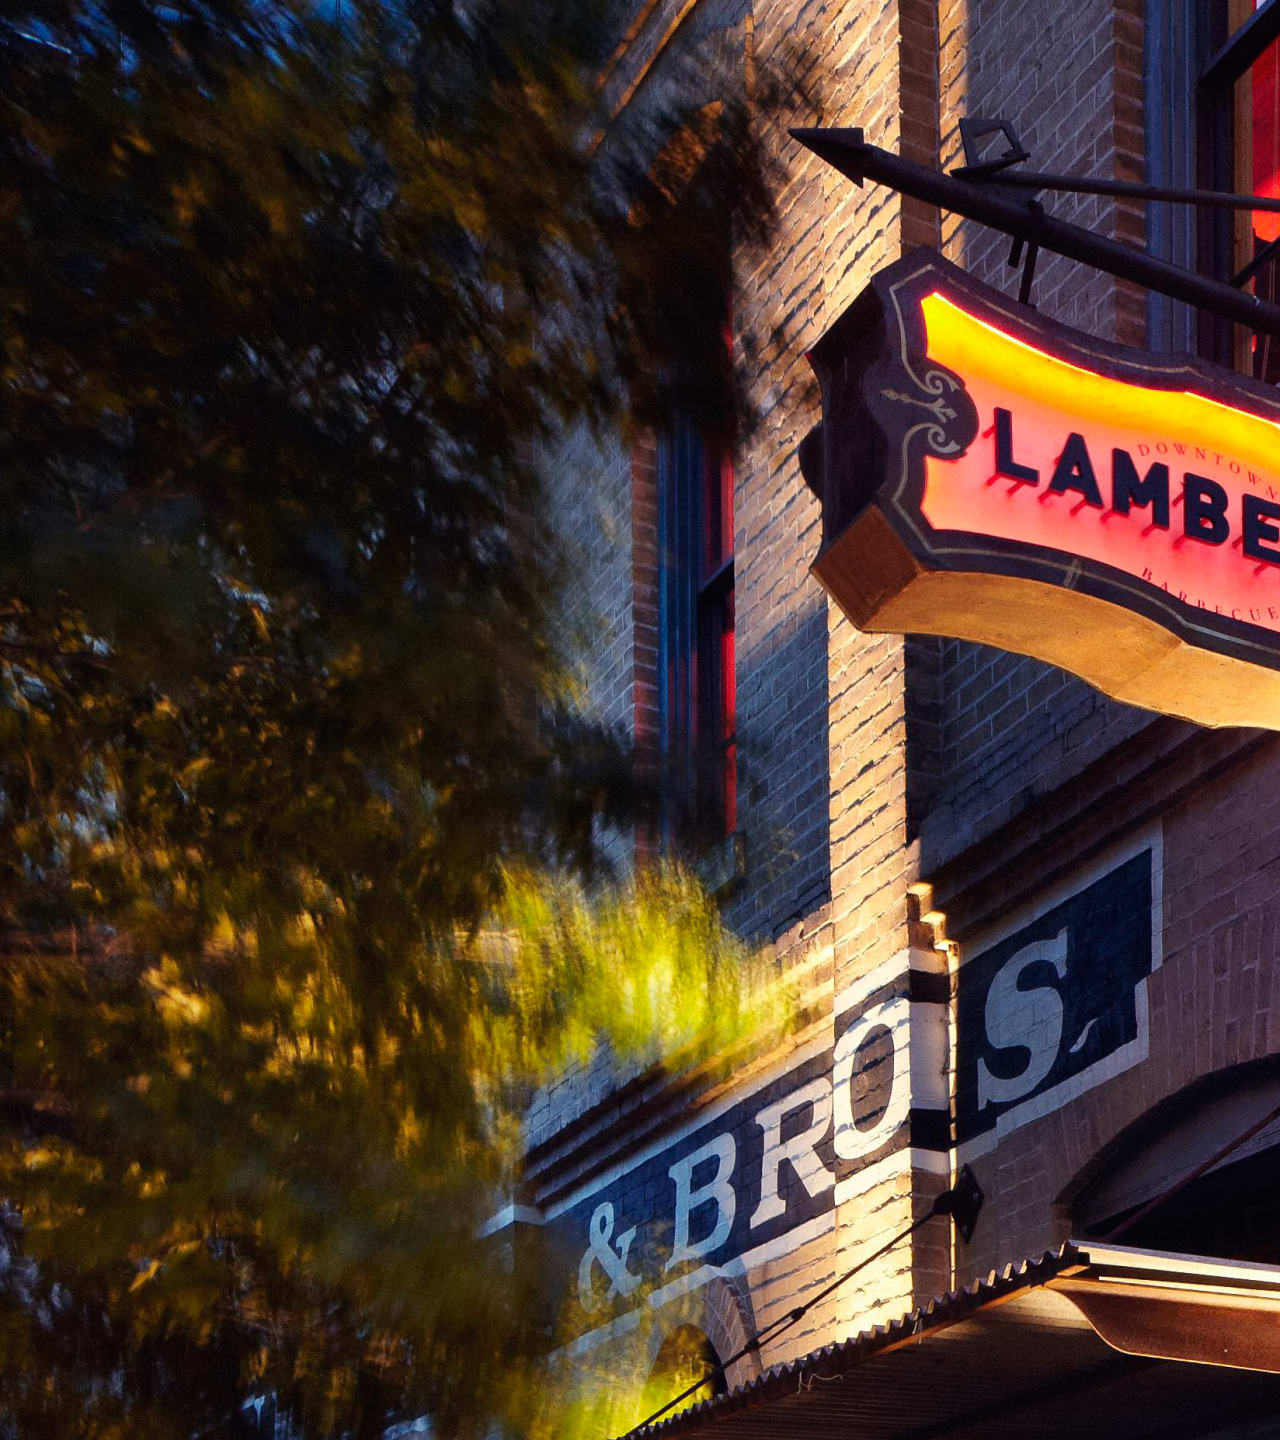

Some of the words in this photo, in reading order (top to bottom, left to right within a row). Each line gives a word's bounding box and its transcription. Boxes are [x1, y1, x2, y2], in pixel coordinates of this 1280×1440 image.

[1137, 442, 1277, 499] DOWNTOWN
[1142, 568, 1279, 621] BARBECUE
[578, 1202, 642, 1313] &
